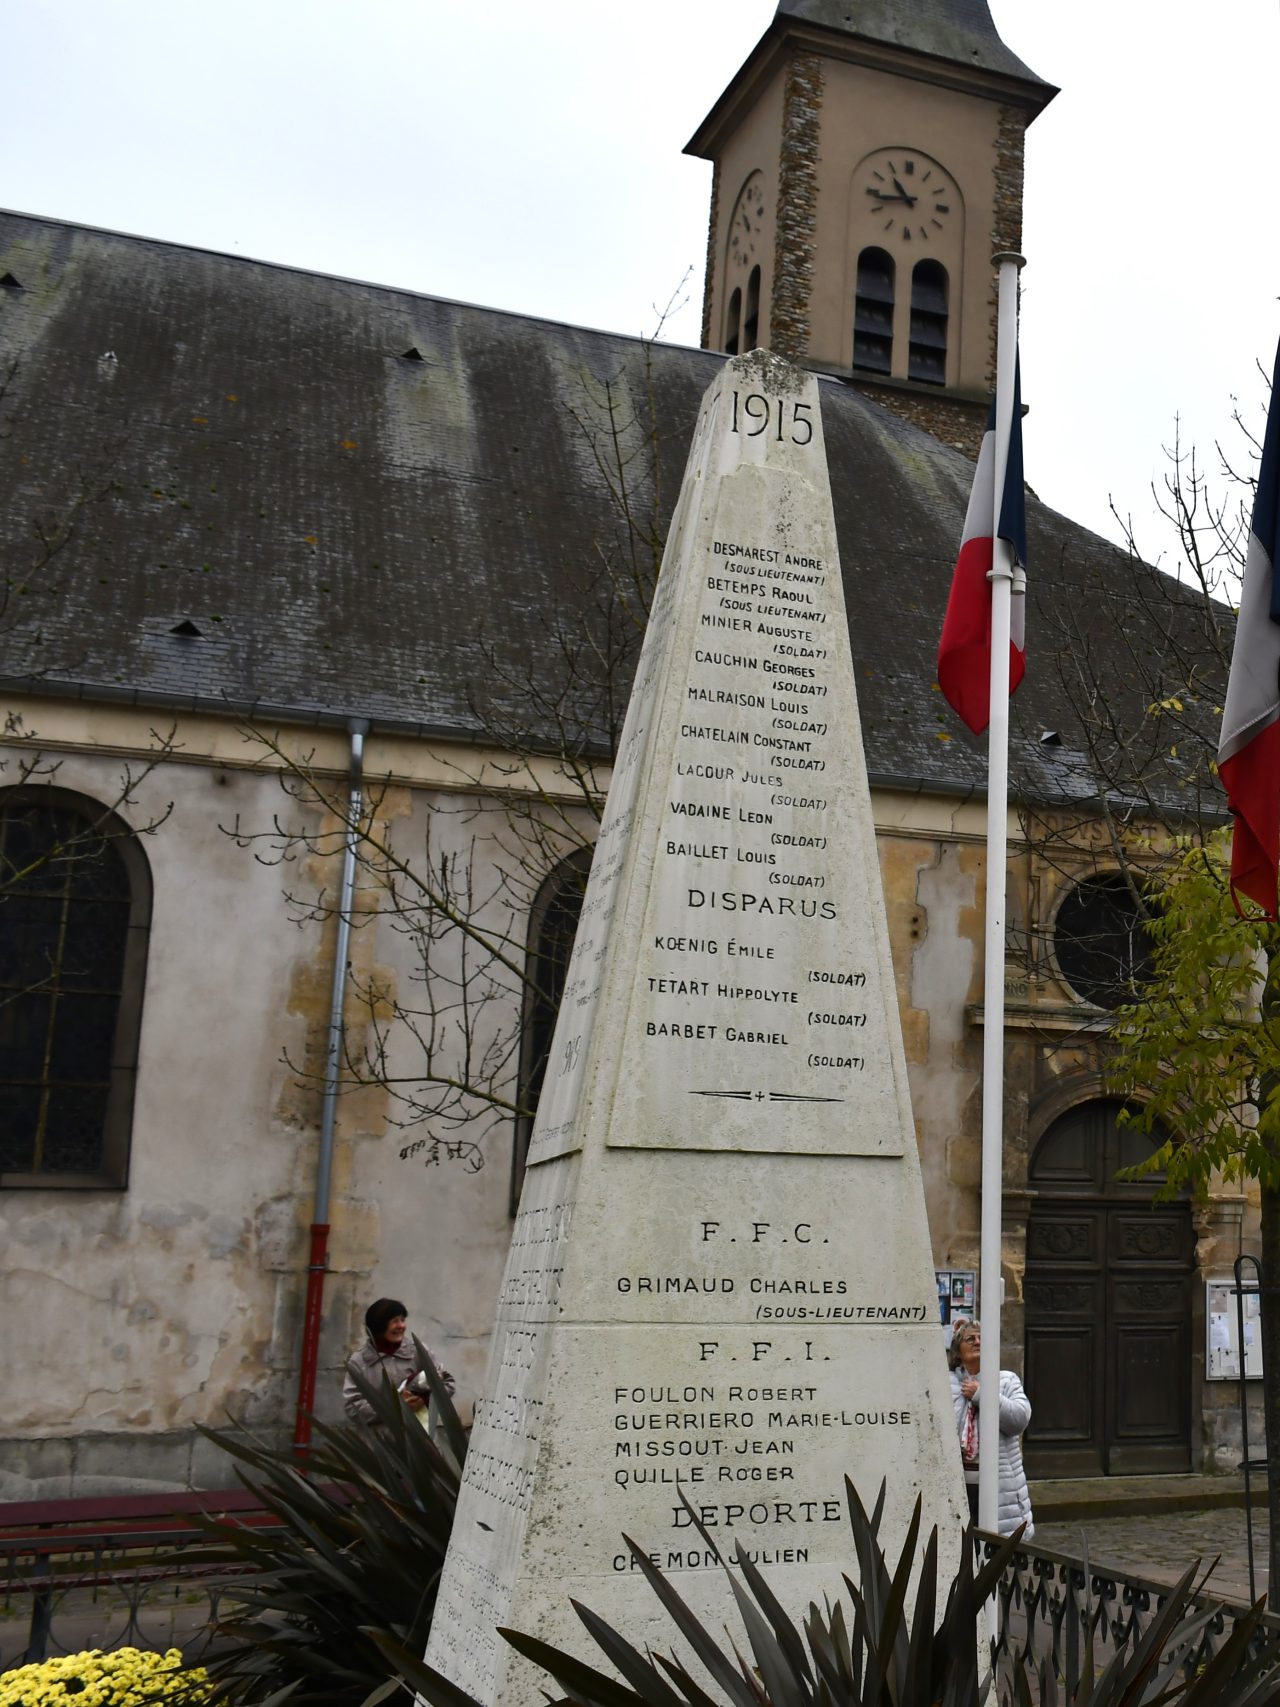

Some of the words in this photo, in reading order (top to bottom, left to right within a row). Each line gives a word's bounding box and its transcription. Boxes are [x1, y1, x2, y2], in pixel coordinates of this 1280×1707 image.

[731, 391, 813, 446] 1915
[713, 541, 780, 563] DESMAREST
[785, 554, 823, 571] ANDRE
[707, 577, 766, 597] BETEMPS
[772, 587, 813, 604] RAOUL
[701, 614, 752, 632] MINIER
[757, 623, 813, 641] AUGUSTE
[773, 644, 827, 659] (SOLDAT)
[695, 650, 757, 669] CAUCHIN
[763, 660, 815, 678] GEORGES
[688, 687, 765, 708] MALRAISON
[771, 698, 809, 715] LOUIS
[772, 718, 828, 736] (SOLDAT)
[681, 725, 749, 744] CHATELAIN
[754, 734, 811, 752] CONSTANT
[771, 755, 826, 771] (SOLDAT)
[677, 763, 734, 780] LACOUR
[742, 771, 783, 787] JULES
[771, 794, 827, 810] (SOLDAT)
[670, 802, 731, 820] VADAINE
[739, 808, 773, 824] LEON
[771, 833, 827, 849] (SOLDAT)
[666, 841, 728, 860] BAILLET
[737, 848, 776, 865] LOUIS
[769, 872, 825, 888] (SOLDAT)
[688, 889, 837, 920] DISPARUS
[727, 938, 775, 959] ÉMILE
[808, 970, 867, 987] (SOLDAT)
[647, 978, 709, 996] TETART
[718, 984, 799, 1003] HIPPOLYTE
[807, 1012, 867, 1027] (SOLDAT)
[646, 1022, 718, 1039] BARBET
[726, 1028, 789, 1045] GABRIEL
[807, 1054, 865, 1071] (SOLDAT)
[617, 1277, 734, 1293] GRIMAUD
[750, 1278, 848, 1294] CHARLES
[756, 1305, 926, 1320] (SOUS-LIEUTENANT)
[615, 1387, 714, 1404] FOULON
[729, 1387, 817, 1402] ROBERT
[615, 1412, 754, 1431] GUERRIERO
[768, 1411, 911, 1428] MARIE-LOUISE
[735, 1439, 794, 1454] JEAN
[615, 1467, 705, 1490] QUILLE
[718, 1466, 794, 1482] ROGER
[671, 1501, 842, 1528] DEPORTE
